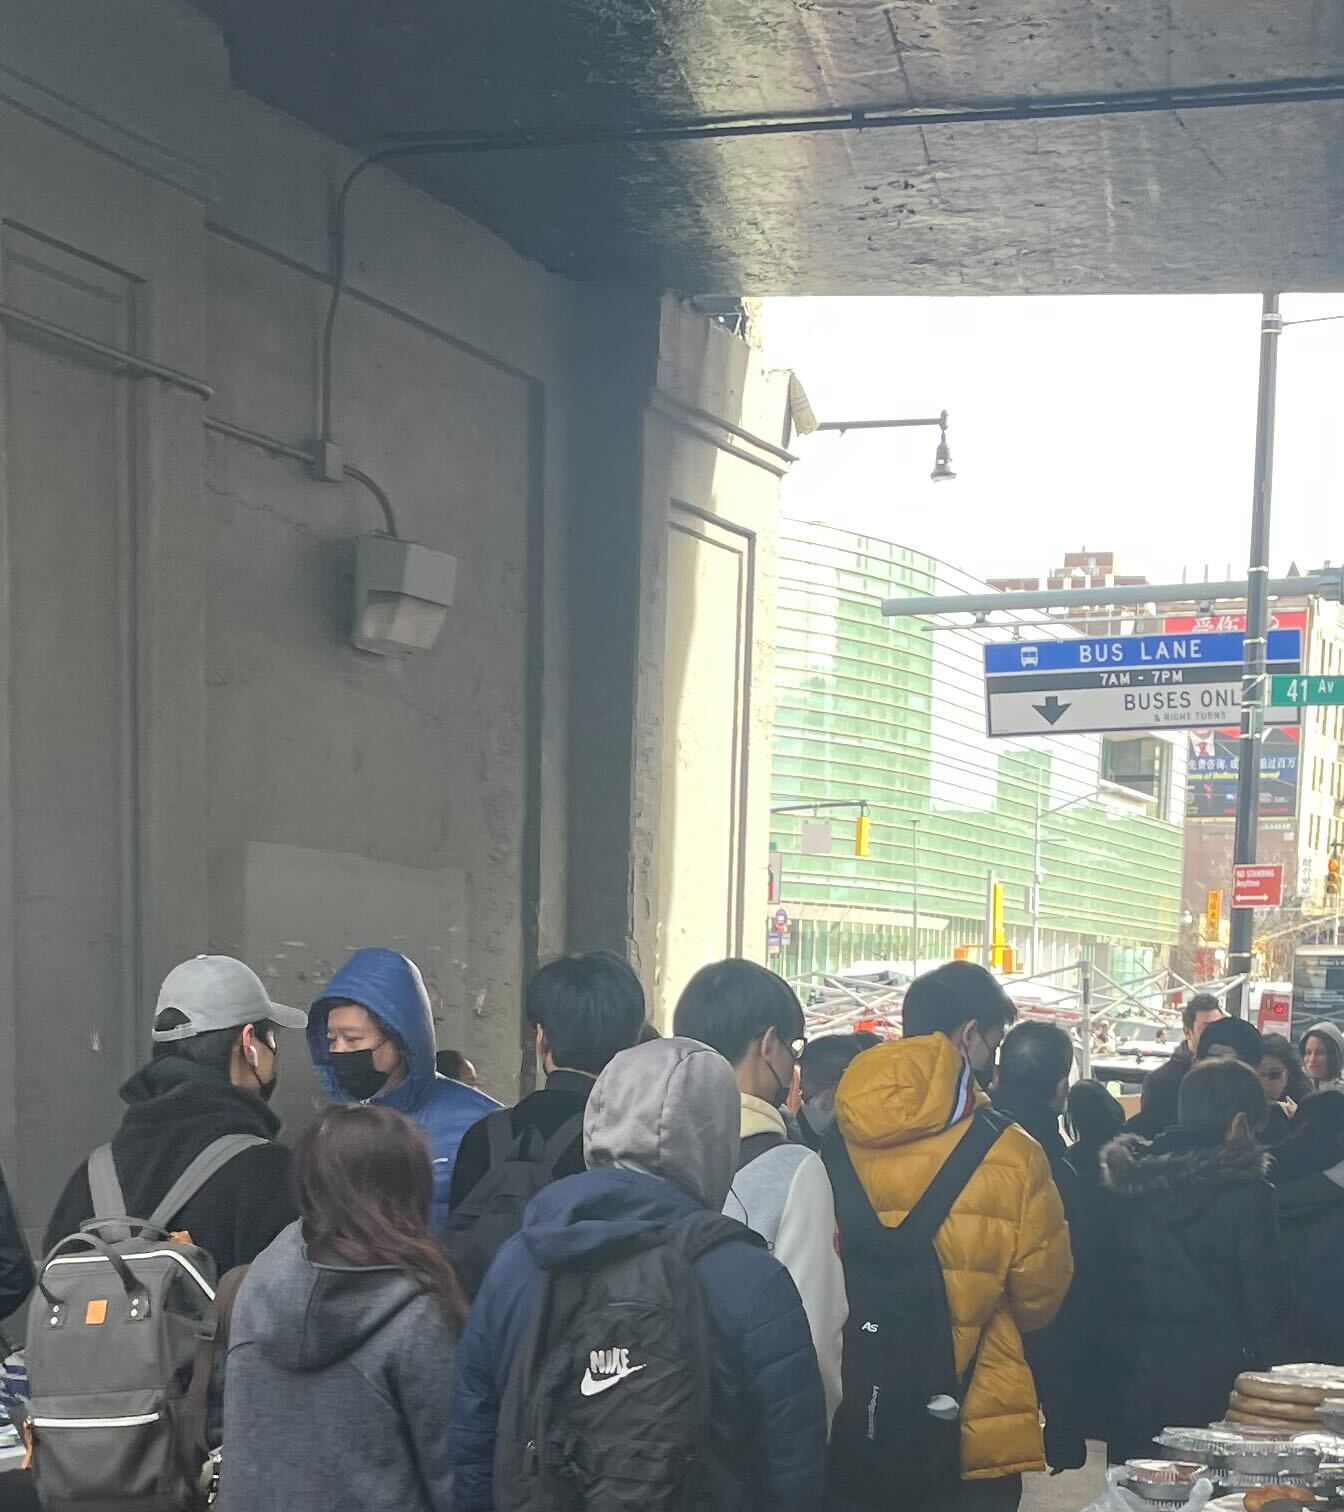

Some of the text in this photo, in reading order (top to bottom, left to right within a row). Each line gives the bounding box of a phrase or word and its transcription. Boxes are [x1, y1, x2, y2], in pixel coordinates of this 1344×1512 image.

[1079, 640, 1202, 663] BUS LANE
[1099, 671, 1130, 686] 7AM
[1152, 670, 1183, 685] 7PM
[1124, 689, 1242, 711] BUSES ONL
[1286, 678, 1335, 702] 41 Av
[590, 1347, 630, 1375] NIKE
